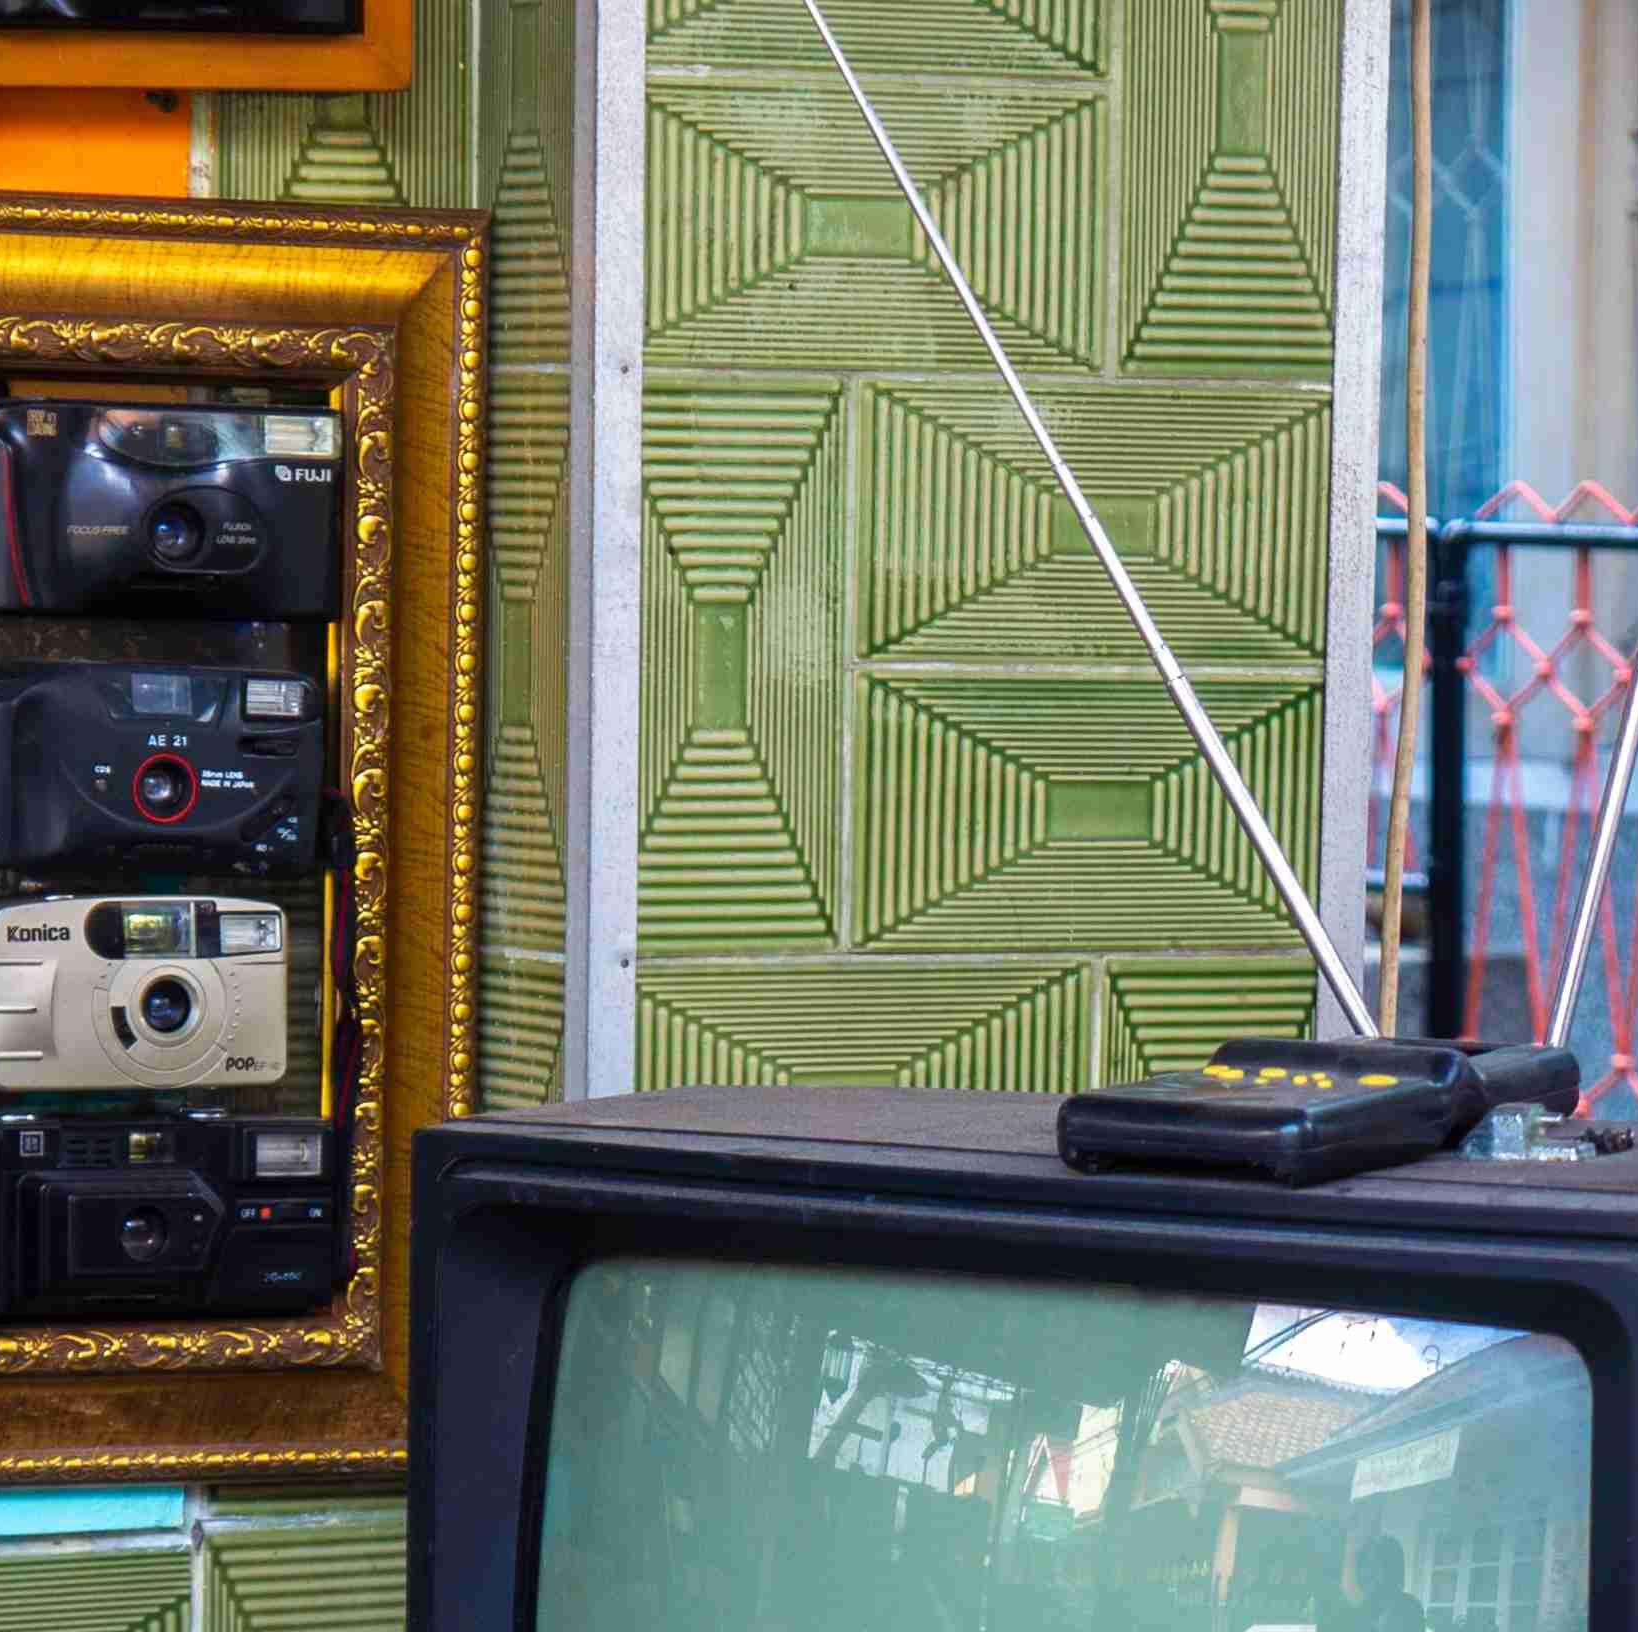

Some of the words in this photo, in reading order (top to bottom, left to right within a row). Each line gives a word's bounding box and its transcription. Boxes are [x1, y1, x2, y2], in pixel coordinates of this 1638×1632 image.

[294, 468, 332, 483] FUJI
[147, 734, 168, 747] AE
[172, 735, 188, 747] 21
[6, 925, 71, 944] Konica
[225, 1056, 255, 1072] POP
